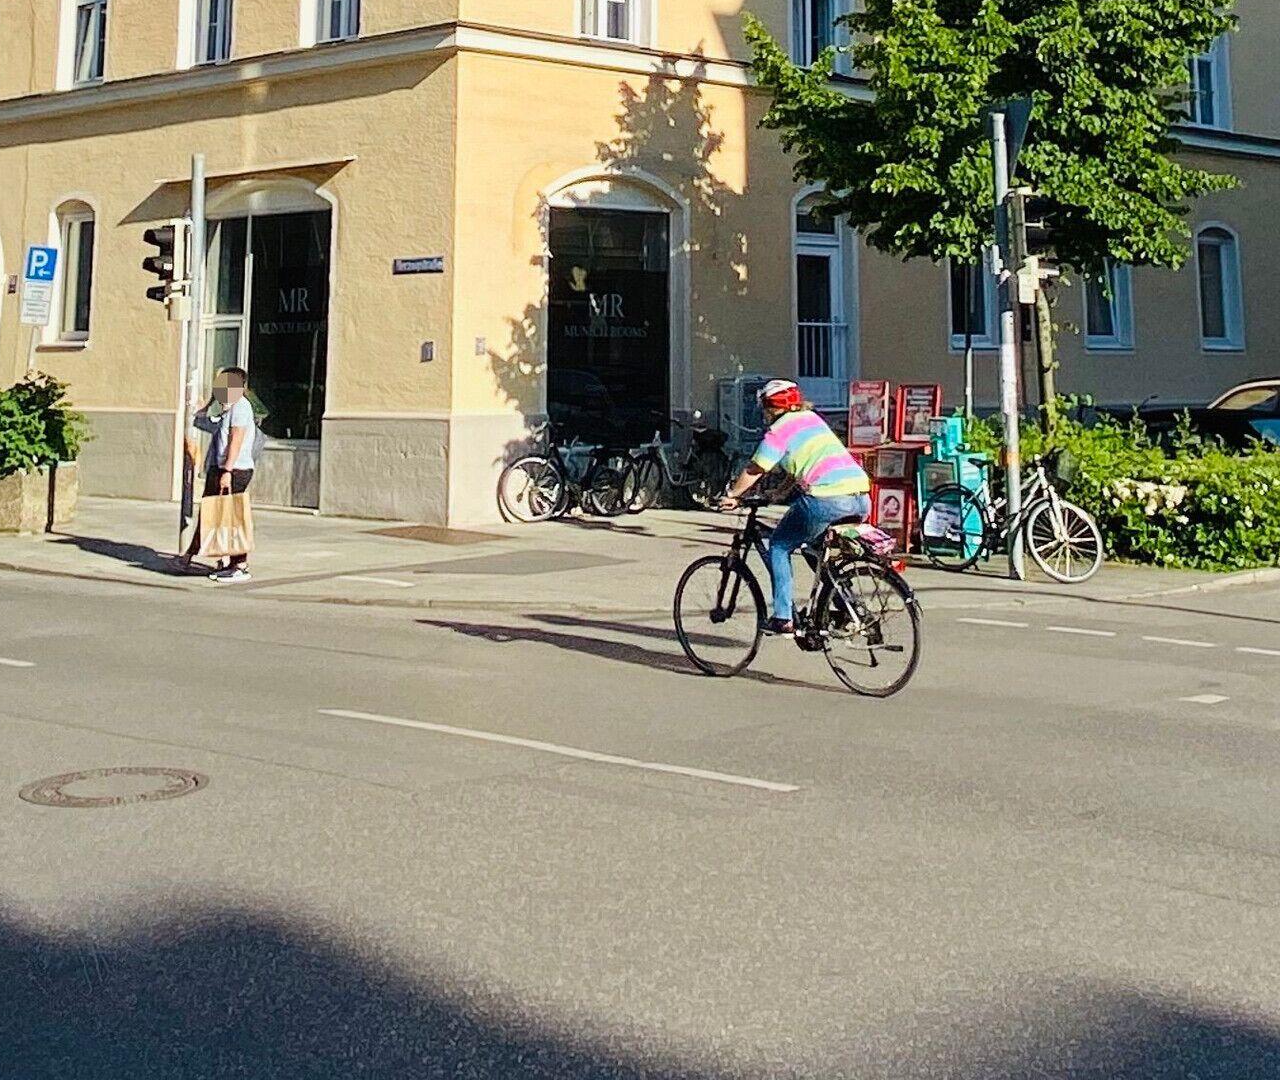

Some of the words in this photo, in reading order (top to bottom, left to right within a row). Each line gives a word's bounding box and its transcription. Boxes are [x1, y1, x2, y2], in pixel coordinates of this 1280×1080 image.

[29, 249, 49, 277] P
[278, 287, 310, 313] MR
[588, 293, 625, 318] MR
